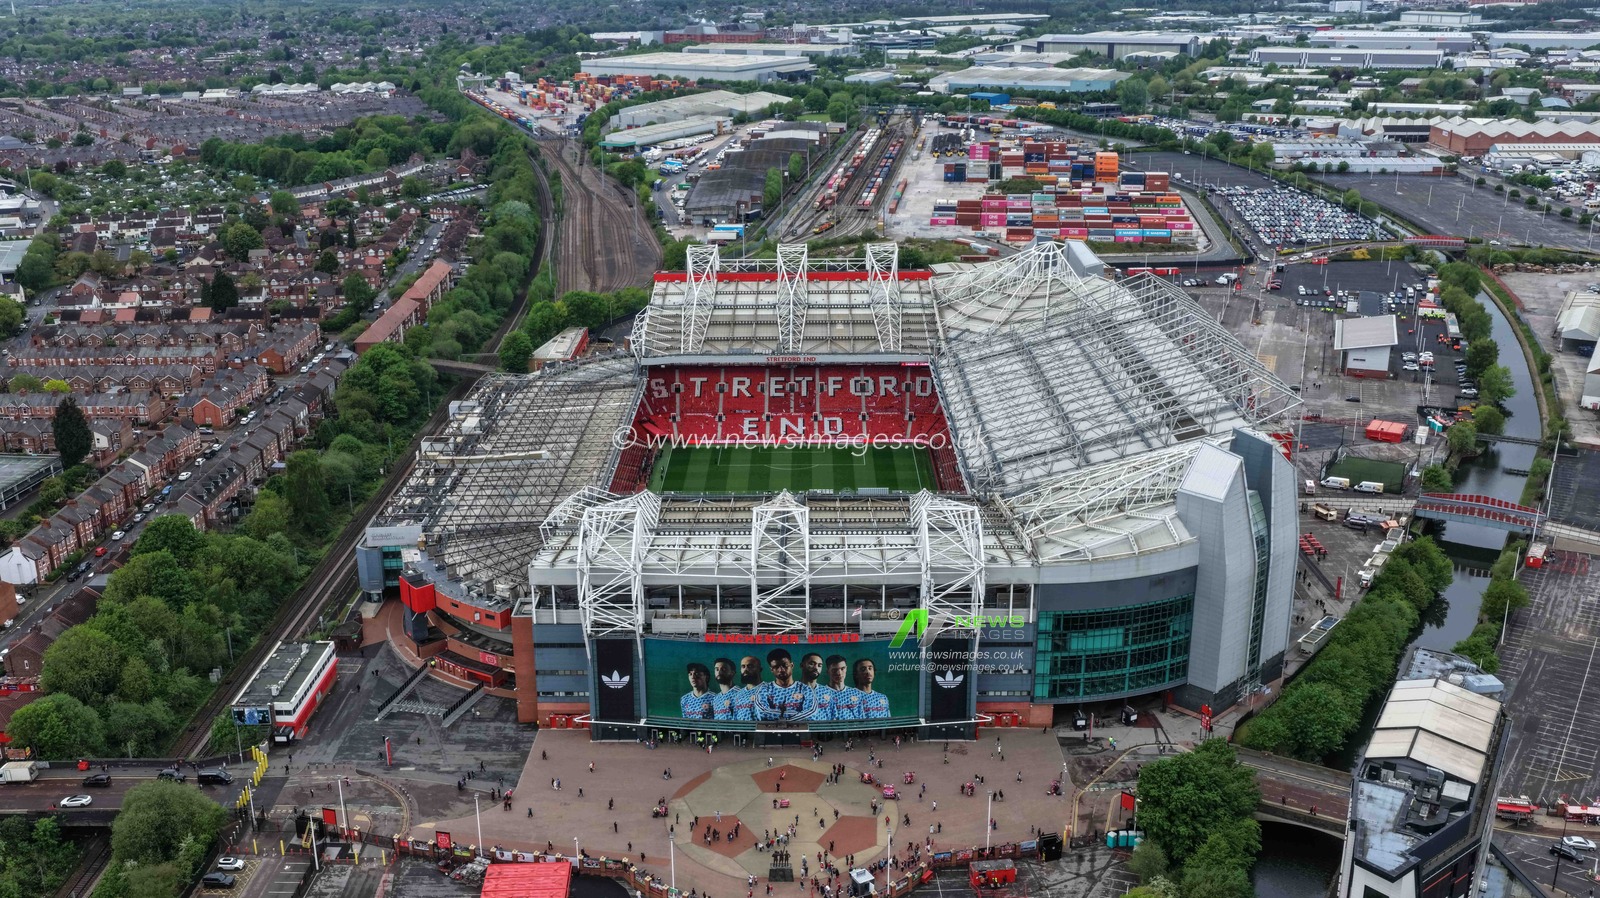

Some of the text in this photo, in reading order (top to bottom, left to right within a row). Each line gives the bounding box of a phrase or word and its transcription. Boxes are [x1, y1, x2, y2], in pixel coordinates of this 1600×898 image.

[650, 376, 933, 399] STRETFORD
[743, 417, 843, 436] END
[705, 632, 860, 644] MANCHESTER UNITED
